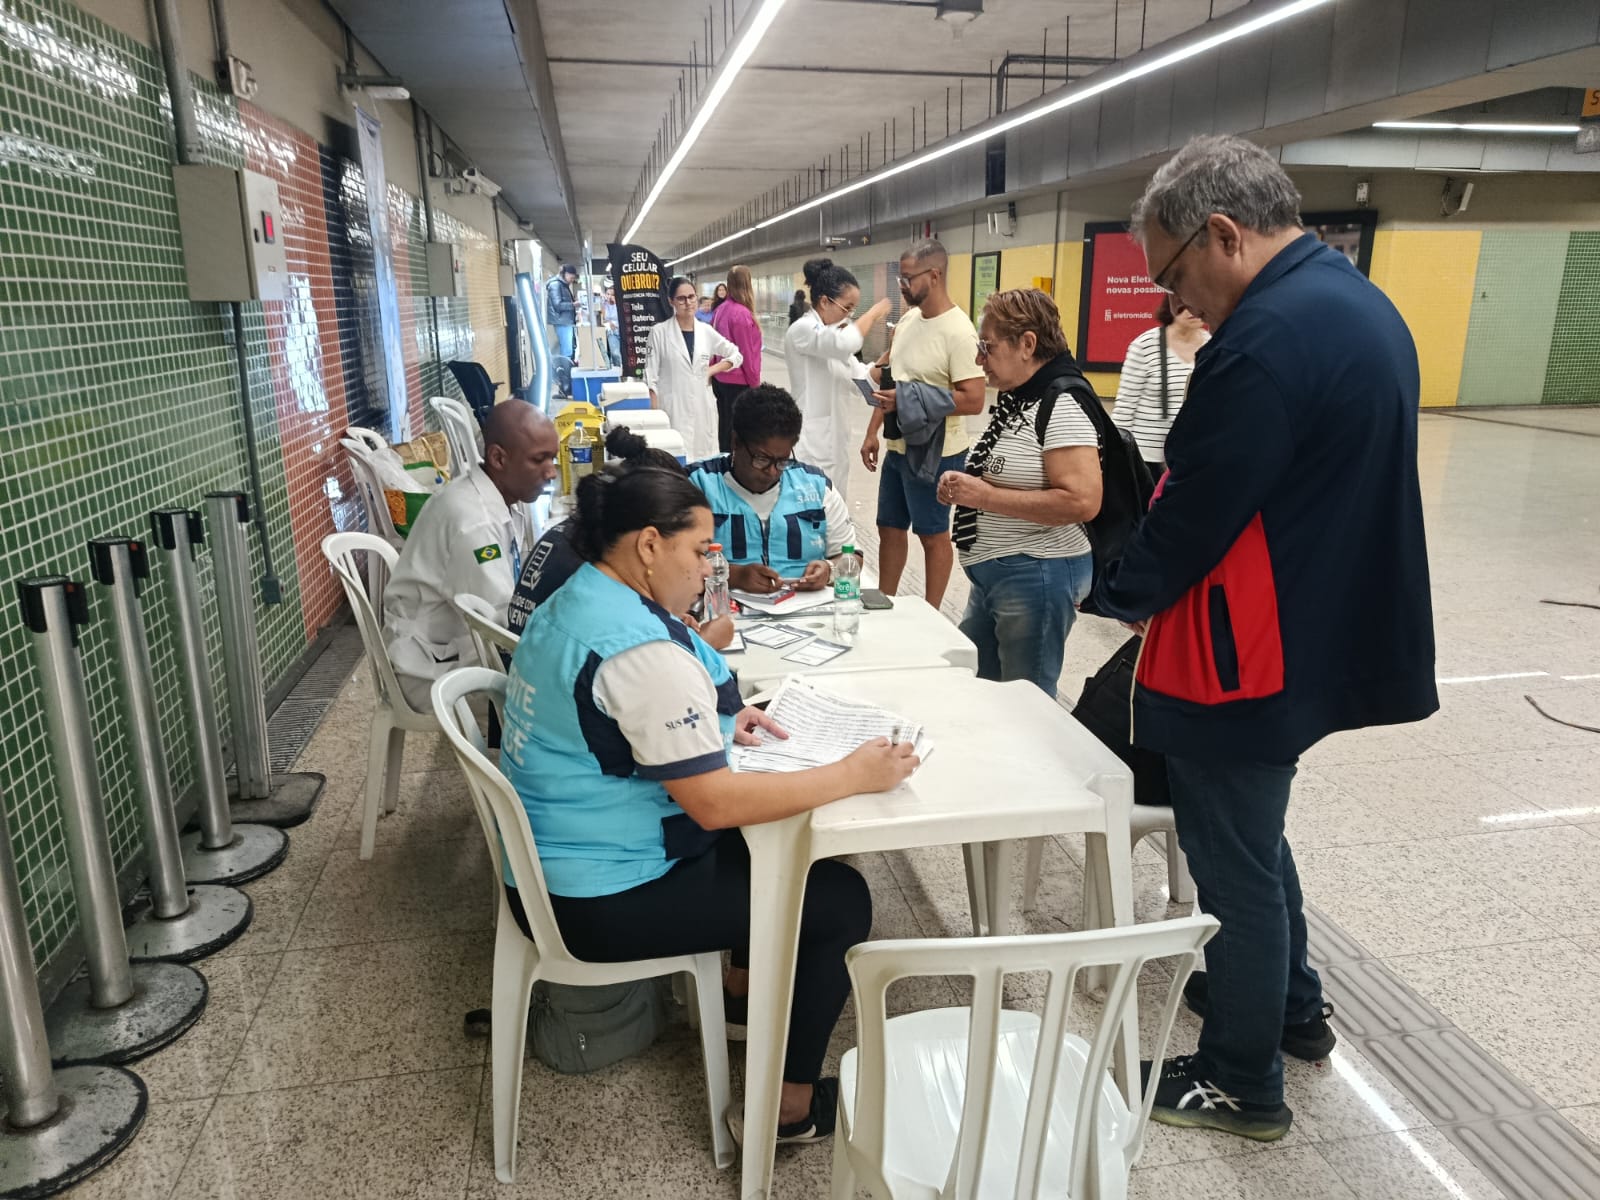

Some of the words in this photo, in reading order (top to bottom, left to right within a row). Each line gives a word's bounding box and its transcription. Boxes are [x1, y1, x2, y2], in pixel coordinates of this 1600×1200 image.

[631, 252, 649, 262] SEU
[622, 263, 658, 273] CELULAR
[620, 274, 660, 291] QUEBROU?
[1107, 276, 1129, 284] Nova
[1106, 287, 1132, 295] novas
[631, 303, 645, 311] Tela
[632, 314, 655, 322] Bateria
[664, 720, 684, 732] SUS
